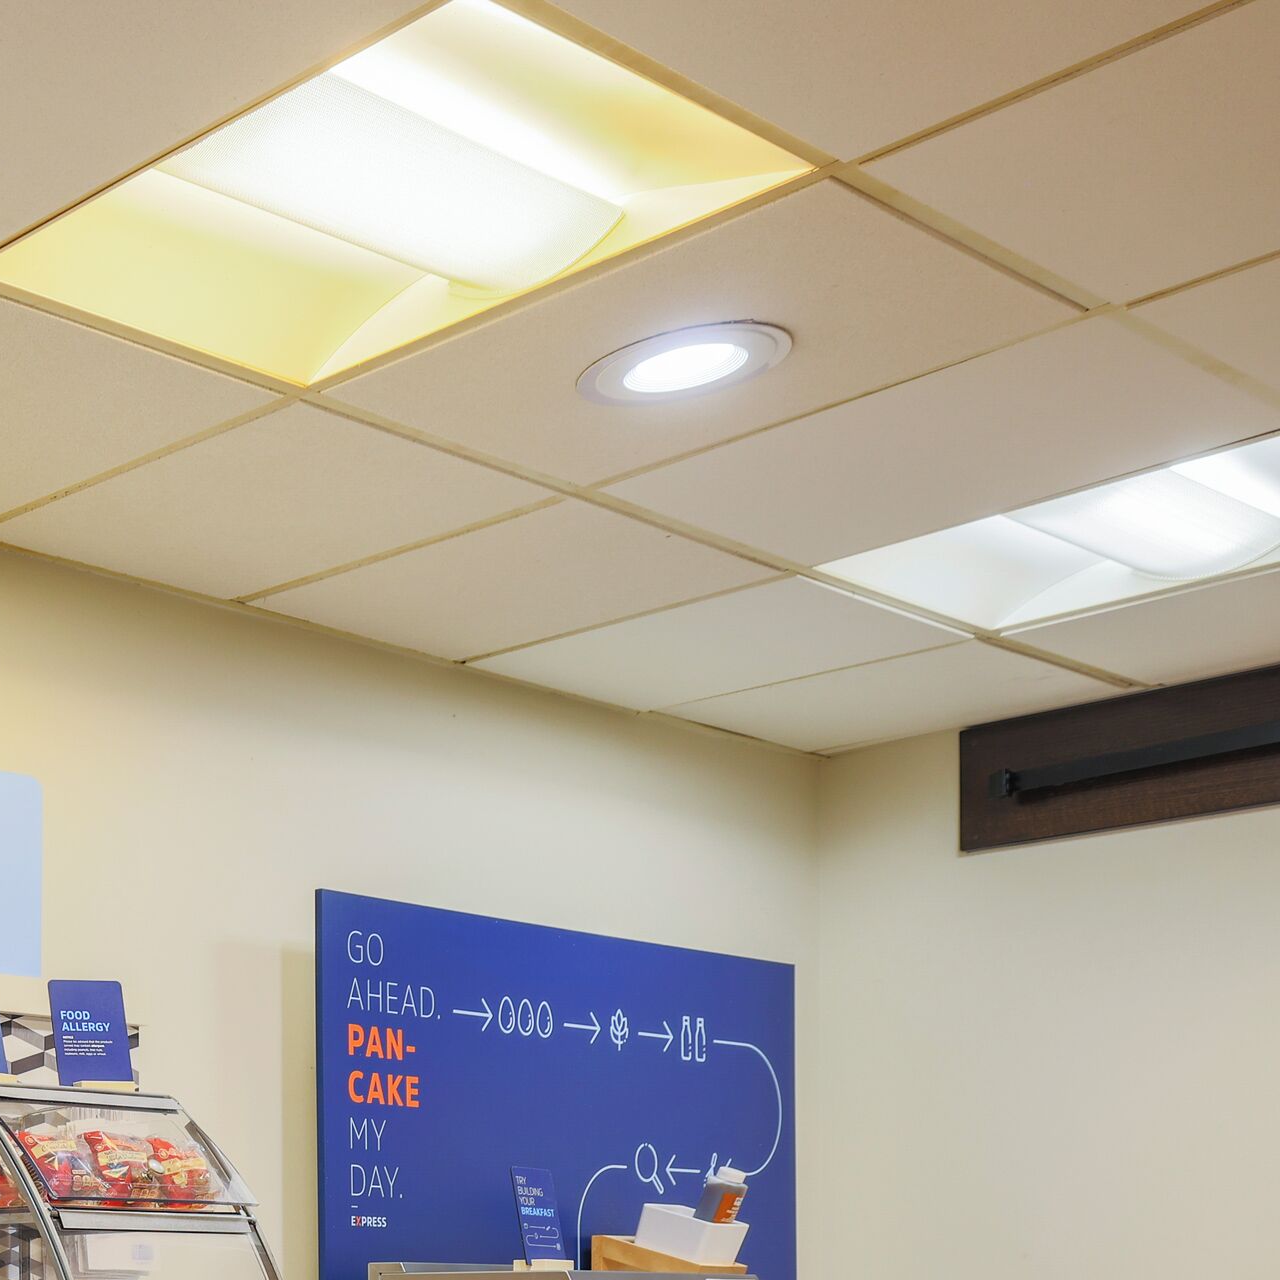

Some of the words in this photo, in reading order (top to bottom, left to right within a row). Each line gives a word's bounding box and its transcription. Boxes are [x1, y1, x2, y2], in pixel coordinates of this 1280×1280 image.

[347, 930, 384, 966] GO
[347, 977, 441, 1019] AHEAD.
[60, 1010, 90, 1020] FOOD
[62, 1022, 110, 1032] ALLERGY
[348, 1023, 416, 1061] PAN-
[348, 1070, 420, 1108] CAKE
[350, 1117, 386, 1151] MY
[351, 1164, 403, 1198] DAY.
[515, 1175, 527, 1185] TRY
[517, 1185, 544, 1197] BUILDING
[519, 1196, 536, 1206] YOUR
[521, 1206, 555, 1217] BREAKFAST
[351, 1215, 387, 1227] EXPRESS
